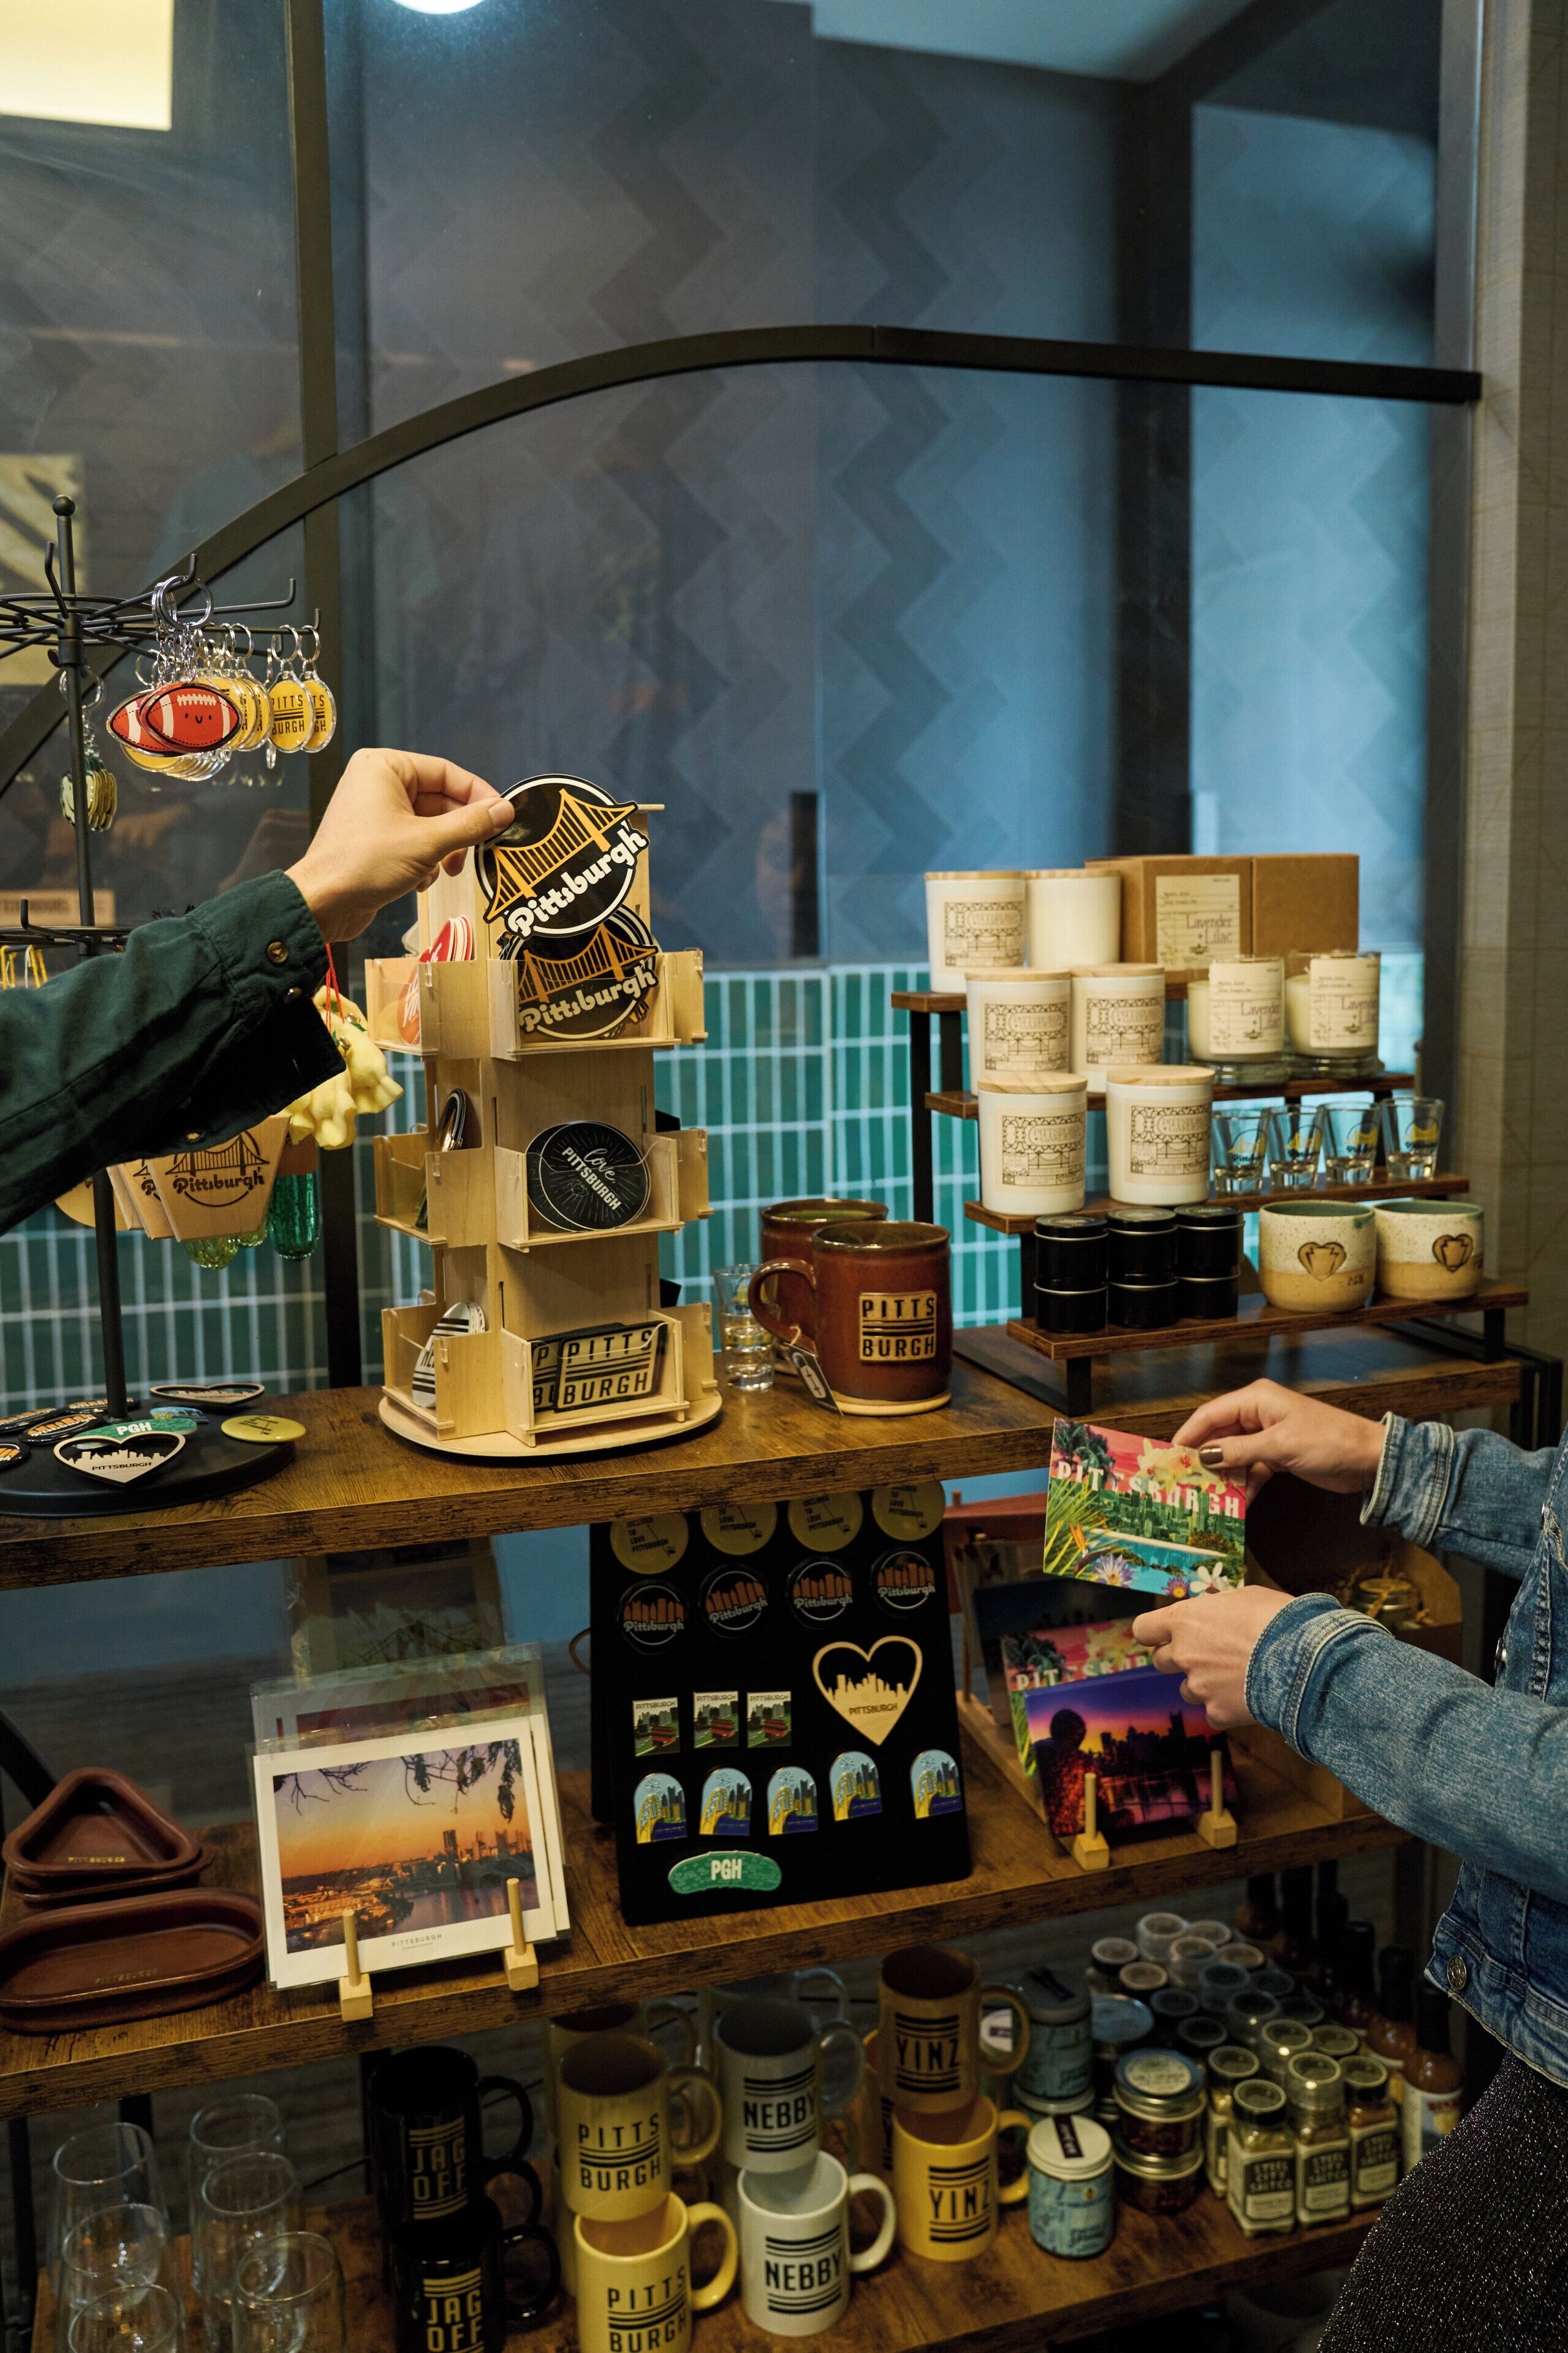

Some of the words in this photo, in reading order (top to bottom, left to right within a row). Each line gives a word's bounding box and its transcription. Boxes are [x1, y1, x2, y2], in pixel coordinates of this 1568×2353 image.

[505, 821, 647, 938] Pittsburgh
[519, 960, 656, 1033] Pittsburgh
[172, 1167, 265, 1194] Pittsburgh
[561, 1146, 622, 1211] PITTSBURGH
[862, 1297, 934, 1319] PITTS
[567, 1329, 653, 1365] PITTS
[862, 1336, 934, 1357] BURGH
[562, 1371, 648, 1405] BURGH
[116, 1422, 152, 1436] PGH
[92, 1461, 152, 1471] PITTSBURGH
[720, 1521, 757, 1532] PITTSBURGH
[807, 1514, 822, 1523] LOVE
[809, 1517, 844, 1531] PITTSBURGH
[630, 1536, 645, 1545] LOVE
[632, 1539, 669, 1553] PITTSBURGH
[793, 1592, 853, 1609] Pittsburgh
[877, 1581, 936, 1598] Pittsburgh
[708, 1596, 769, 1624] Pittsburgh
[623, 1618, 685, 1633] Pittsburgh
[635, 1701, 676, 1710] PITTSBURGH
[849, 1703, 898, 1716] PITTSBURGH
[710, 1858, 743, 1881] PGH
[392, 1933, 442, 1947] PITTSBURGH
[896, 2037, 960, 2071] YINZ
[744, 2086, 816, 2130] NEBBY
[578, 2112, 660, 2148] PITTS
[413, 2136, 466, 2175] JAG
[413, 2162, 467, 2201] OFF
[580, 2156, 661, 2192] BURGH
[930, 2180, 989, 2220] YINZ
[765, 2248, 843, 2291] NEBBY
[608, 2265, 686, 2309] PITTS
[426, 2288, 483, 2326] JAG
[426, 2314, 483, 2352] OFF
[610, 2310, 686, 2353] BURGH
